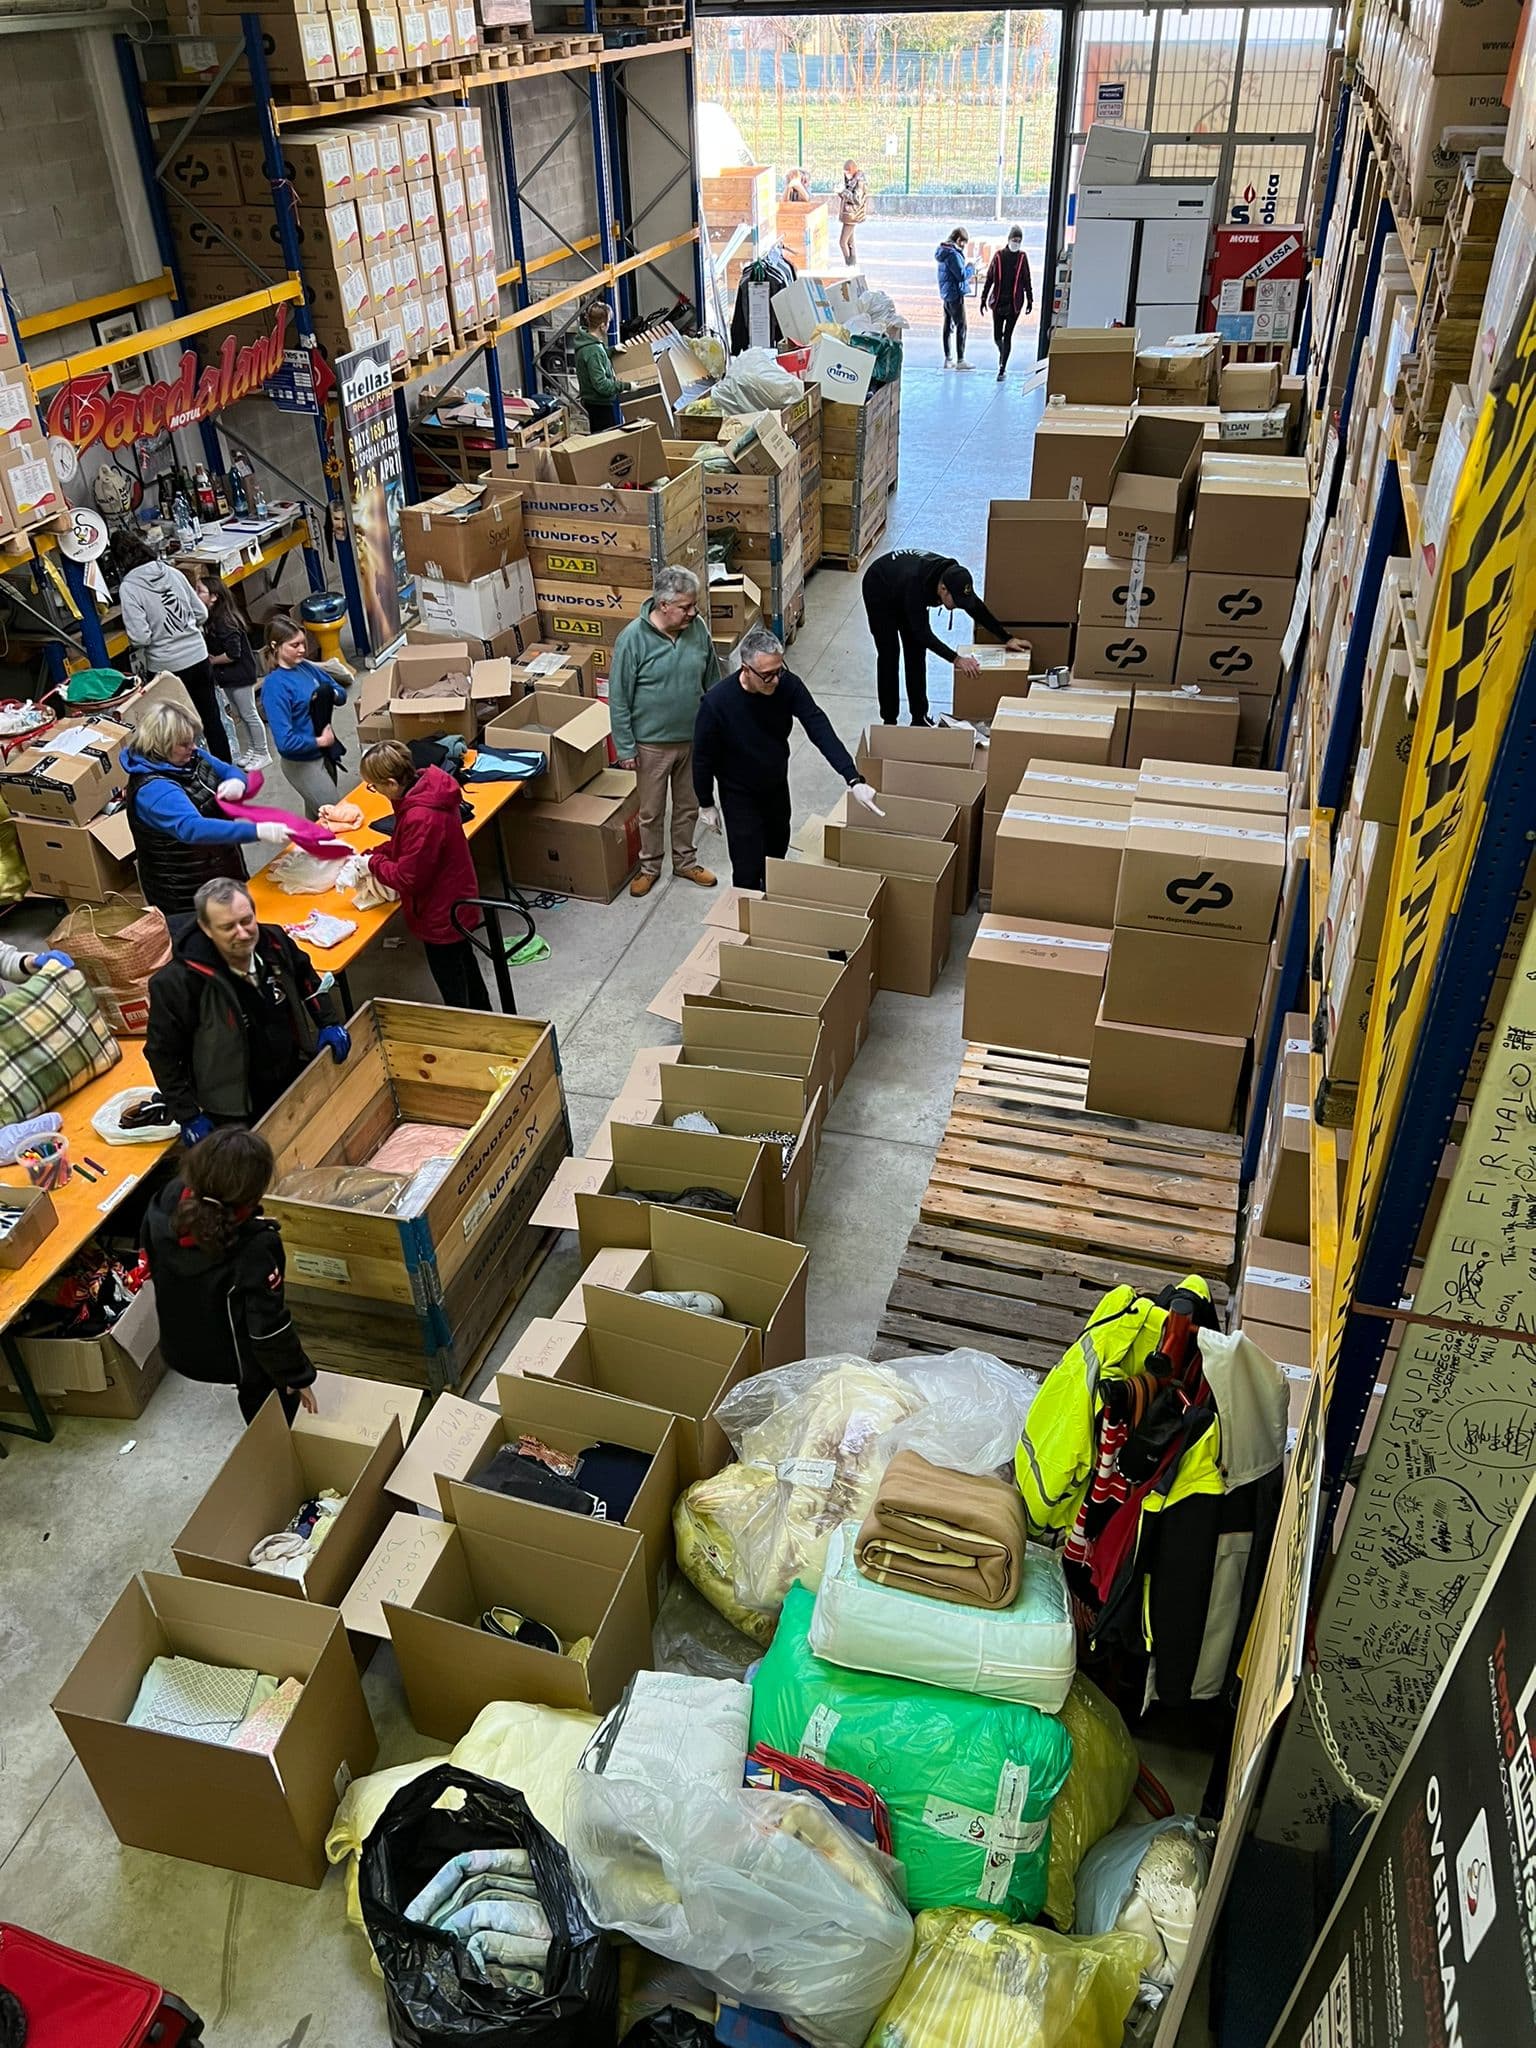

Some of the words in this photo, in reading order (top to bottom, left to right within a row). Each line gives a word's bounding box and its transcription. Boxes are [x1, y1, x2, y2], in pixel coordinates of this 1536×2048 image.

[1229, 234, 1260, 244] MOTUL
[1264, 244, 1292, 268] LISSA
[48, 301, 287, 459] Gardaland
[346, 370, 391, 404] Hellas
[352, 395, 376, 415] RALLY
[375, 386, 394, 402] RAID
[170, 407, 203, 429] MOTUL
[354, 428, 371, 451] DAYS
[359, 442, 382, 469] SPECIAL
[524, 527, 600, 545] GRUNDFOS
[1118, 531, 1167, 543] DEPTTO
[550, 556, 596, 573] DAB
[536, 592, 605, 608] RUNDFOS
[555, 618, 600, 634] DAB
[1466, 1062, 1532, 1206] FIRMALO
[457, 1104, 521, 1196] GRUNDFOS
[487, 1142, 527, 1202] NDFOS
[1450, 1236, 1476, 1255] E
[1350, 1452, 1400, 1563] PENSIERO
[385, 1525, 441, 1604] SCARPE
[1335, 1573, 1361, 1609] TUO
[1329, 1616, 1353, 1633] IL
[1319, 1640, 1342, 1672] QUI
[1516, 1752, 1536, 1850] Film
